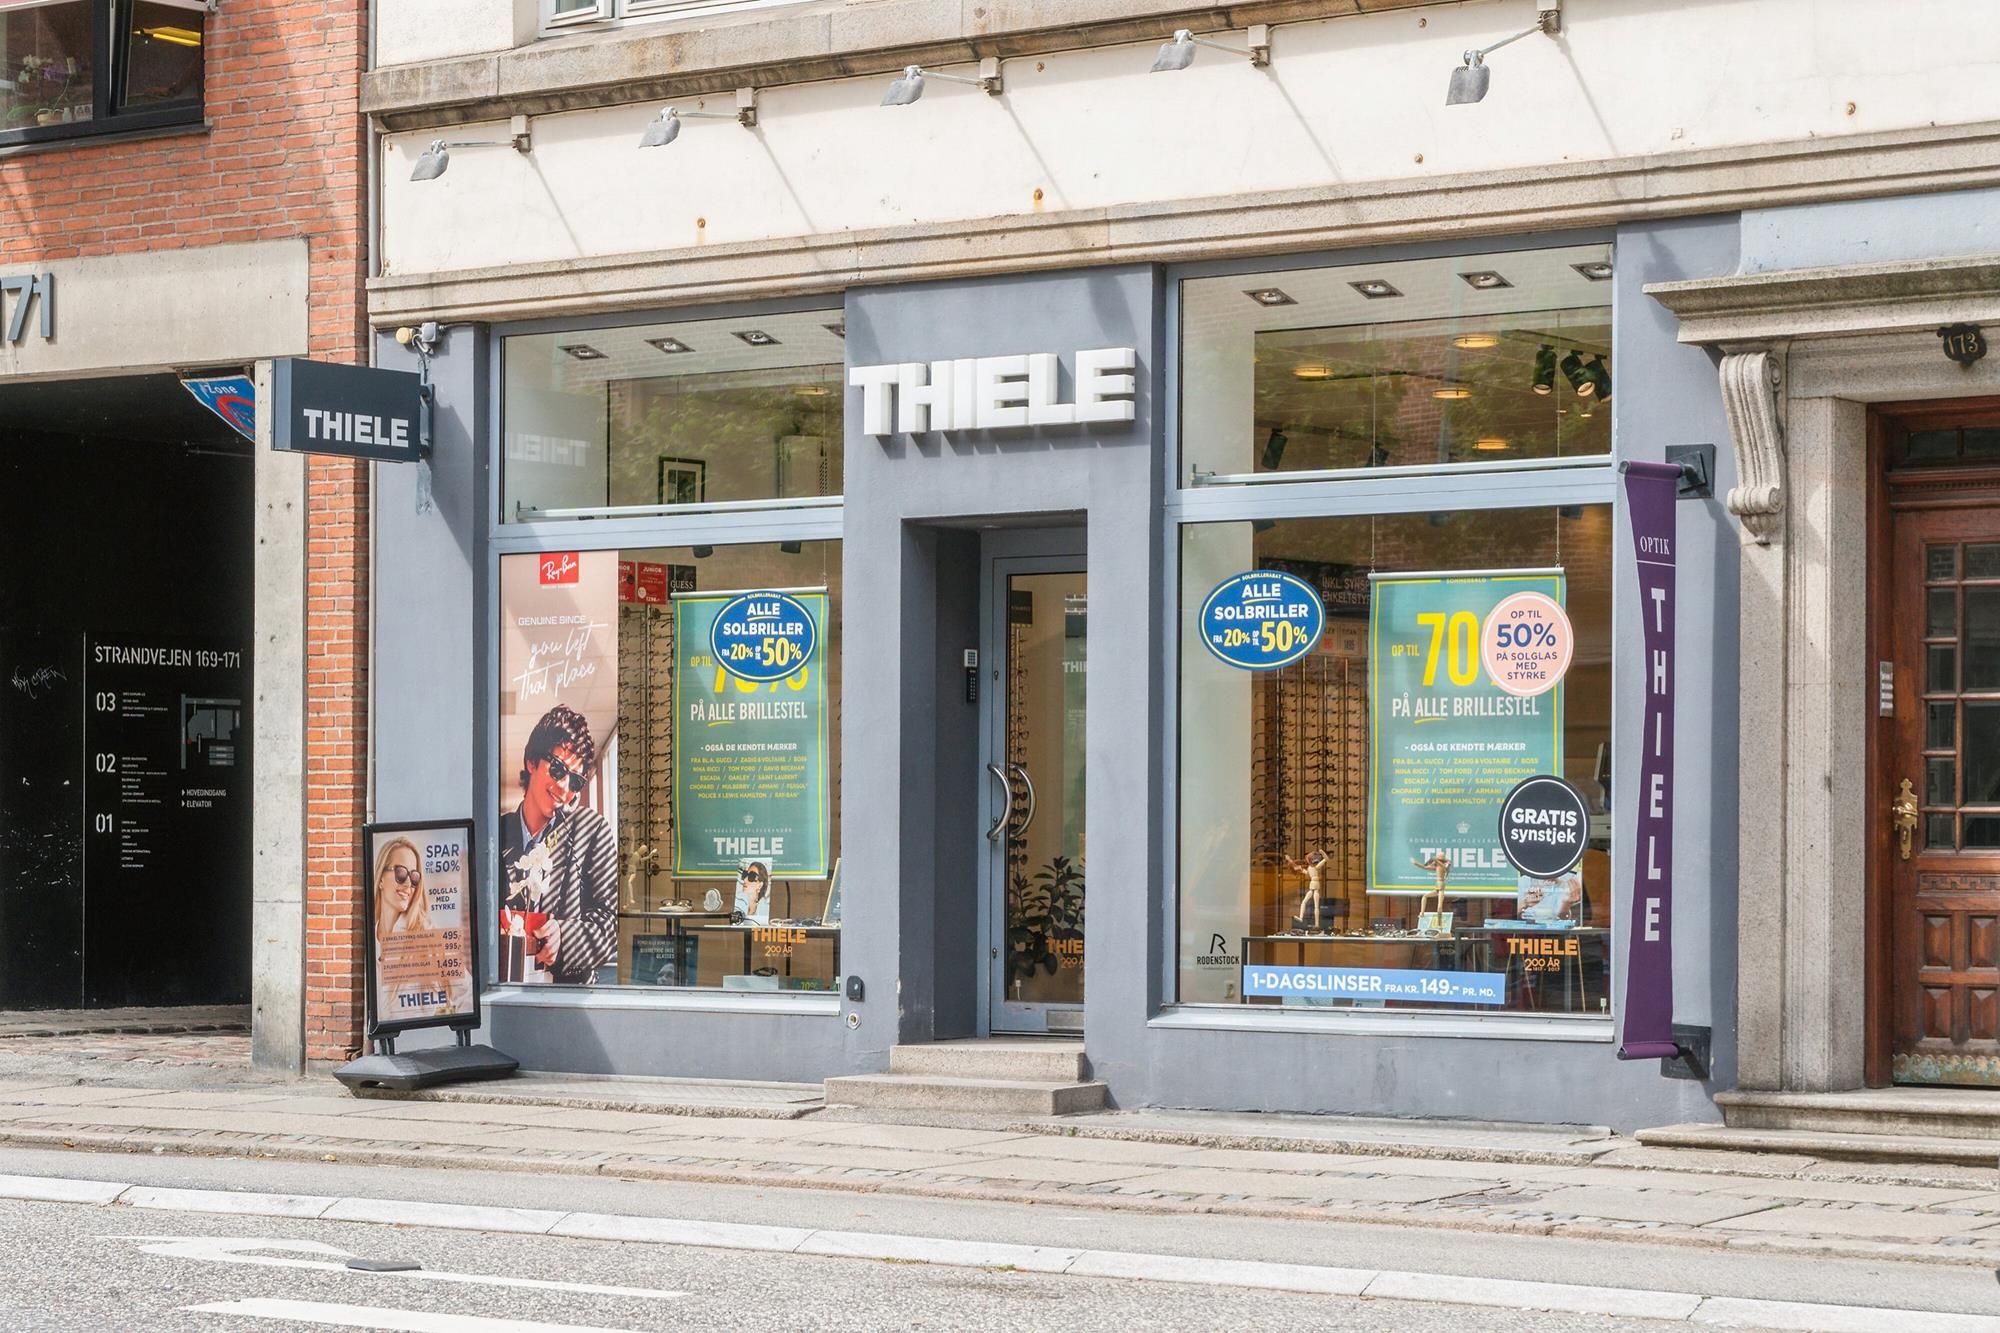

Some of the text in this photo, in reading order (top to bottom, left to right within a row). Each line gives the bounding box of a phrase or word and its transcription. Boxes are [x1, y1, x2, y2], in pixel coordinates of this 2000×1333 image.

[1948, 332, 1979, 355] 173
[204, 384, 238, 394] Zone
[849, 347, 1136, 436] THIELE
[303, 408, 409, 448] THIELE
[1640, 535, 1670, 555] OPTIK
[542, 555, 577, 580] Ray-Ban
[670, 580, 694, 589] GUESS
[1242, 583, 1281, 598] ALLE
[747, 603, 780, 615] ALLE
[1214, 604, 1309, 620] SOLBRILLER
[1510, 610, 1542, 619] OP TIL
[518, 615, 585, 626] GENUINE SINCE
[723, 622, 803, 635] SOLBRILLER
[1213, 635, 1223, 643] FRA
[1224, 628, 1250, 647] 20%
[1252, 630, 1259, 638] OP
[1261, 620, 1308, 653] 50%
[1496, 622, 1556, 648] 50%
[95, 645, 240, 668] STRANDVEJEN 169-171
[730, 643, 753, 660] 20%
[762, 637, 802, 666] 50%
[1392, 611, 1488, 687] OP TIL 70
[1496, 651, 1557, 661] PÅ SOLGLAS
[691, 656, 712, 667] OP TIL
[1062, 661, 1087, 673] THI
[1516, 662, 1537, 670] MED
[1507, 671, 1546, 680] STYRKE
[96, 692, 116, 711] 03
[691, 698, 807, 720] PÅ ALLE BRILLESTEL
[1392, 692, 1539, 717] PÅ ALLE BRILLESTEL
[705, 743, 724, 751] OGSÅ
[767, 743, 797, 751] MÆRKER
[1410, 743, 1526, 751] OGSÅ DE KENDTE MÆRKER
[96, 753, 116, 773] 02
[1645, 587, 1667, 941] THIELE
[186, 800, 212, 808] ELEVATOR
[96, 813, 113, 833] 01
[1511, 808, 1577, 826] GRATIS
[1511, 827, 1576, 845] synstjek
[426, 843, 459, 858] SPAR
[713, 837, 784, 855] THIELE
[435, 860, 461, 873] 50%
[428, 887, 458, 895] SOLGLAS
[431, 903, 456, 911] STYRKE
[751, 928, 807, 944] THIELE
[764, 944, 792, 957] 200 ÅR
[1045, 937, 1083, 953] THIE
[1507, 938, 1578, 955] THIELE
[1196, 956, 1240, 965] RODENSTOCK
[1524, 957, 1560, 971] 200 ÅR
[1251, 972, 1382, 992] 1-DAGSLINSER
[1385, 984, 1402, 993] FRA
[1404, 985, 1419, 994] KR.
[1463, 987, 1477, 997] PR.
[1479, 987, 1496, 998] MD.
[398, 990, 447, 1008] THIELE
